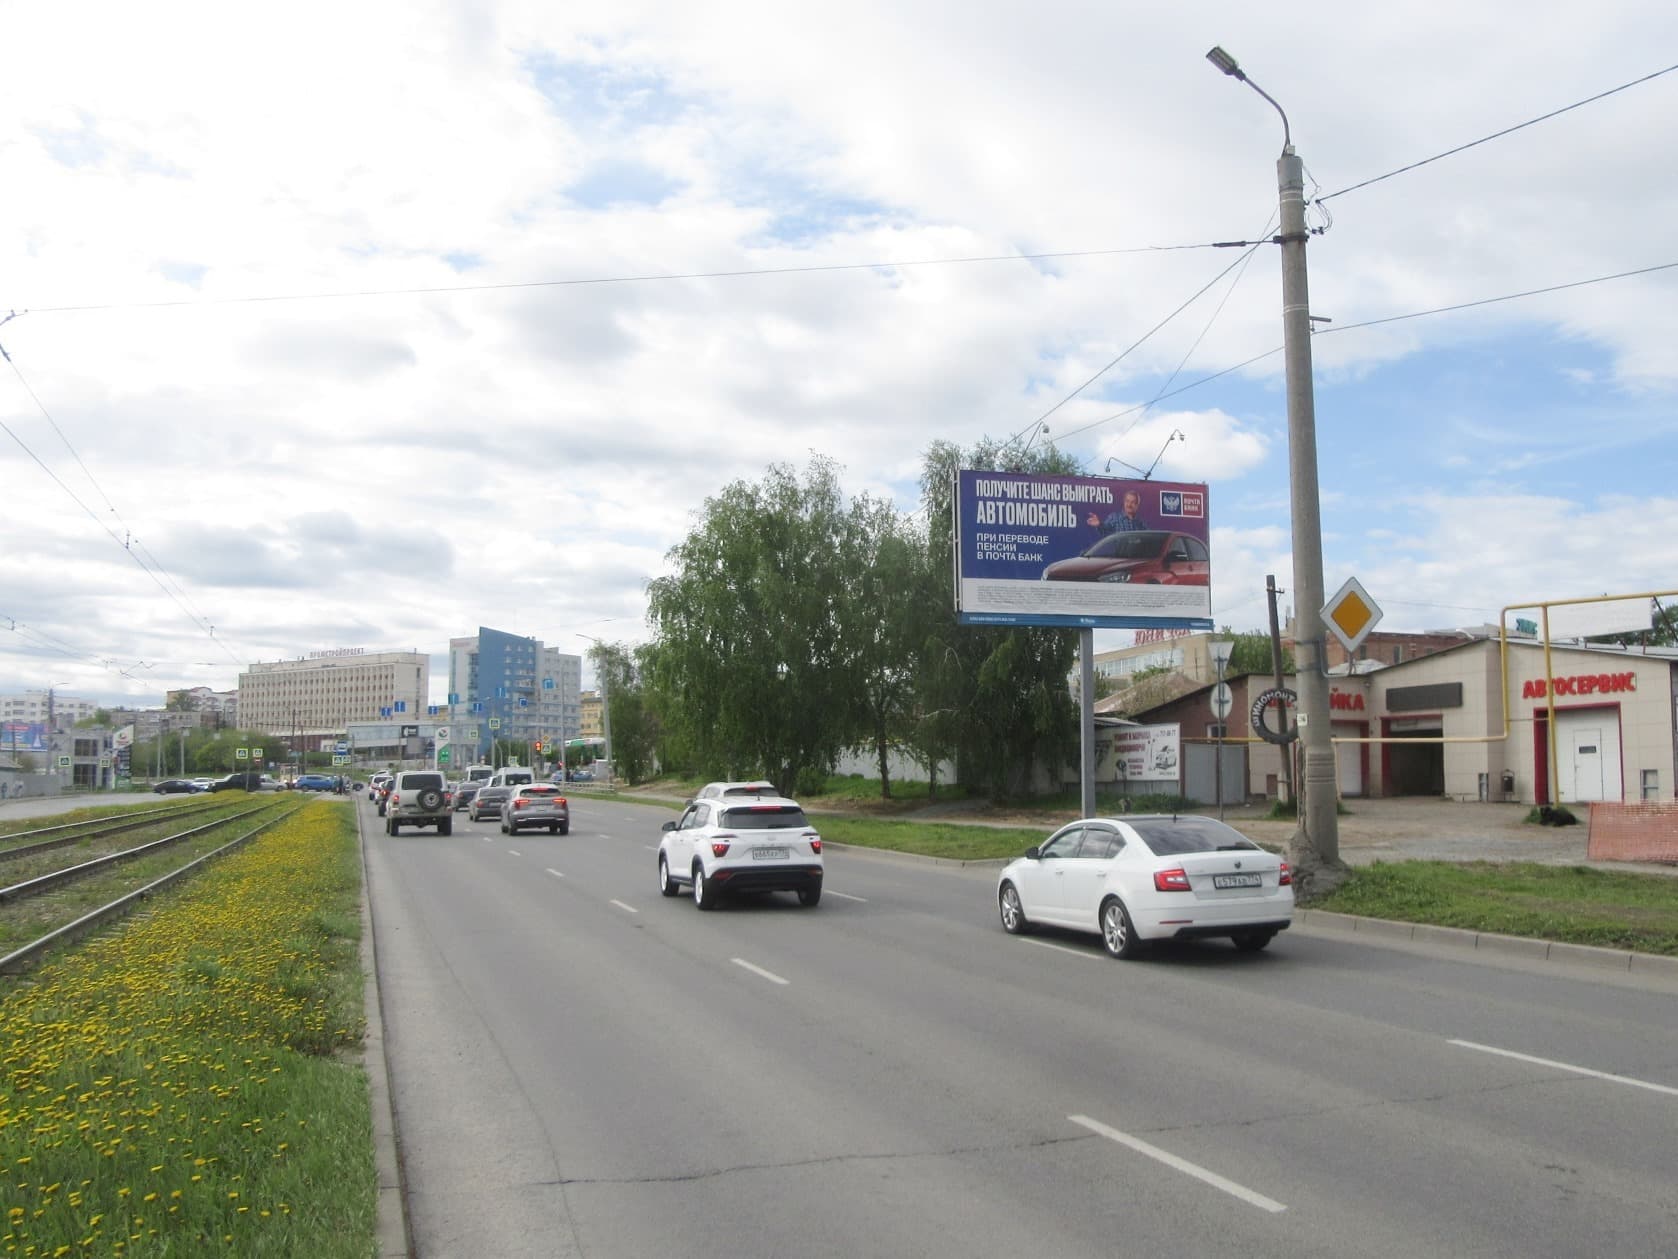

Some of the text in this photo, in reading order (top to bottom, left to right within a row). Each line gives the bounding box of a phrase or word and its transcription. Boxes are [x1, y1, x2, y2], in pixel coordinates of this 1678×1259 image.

[976, 479, 1113, 504] ПОЛУЧИТЕ ШАНС ВЫИГРАТЬ
[976, 501, 1077, 528] АВТОМОБИЛЬ
[976, 533, 1049, 545] ПРИ ПЕРЕВОДЕ
[976, 542, 1017, 552] ПЕНСИИ
[977, 552, 1044, 562] В ПОЧТА БАНК
[1522, 671, 1637, 699] АВОСЕРВИС
